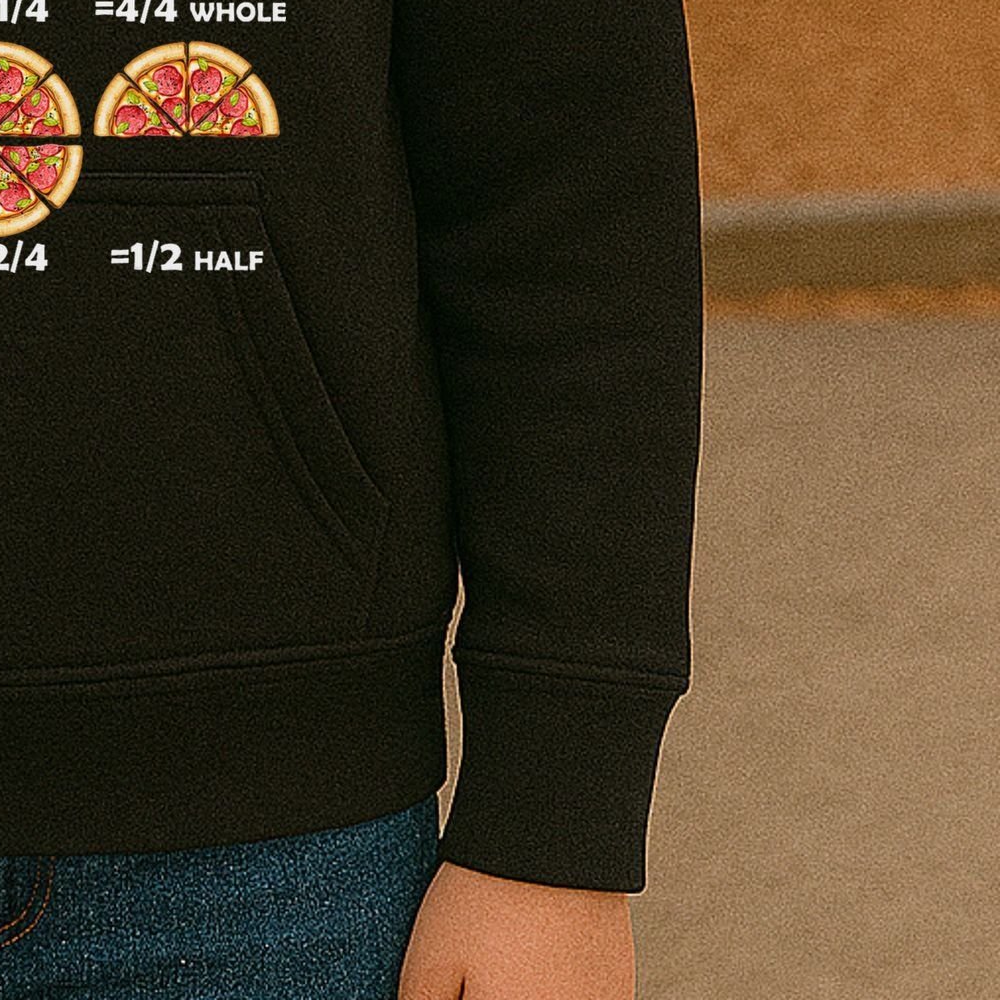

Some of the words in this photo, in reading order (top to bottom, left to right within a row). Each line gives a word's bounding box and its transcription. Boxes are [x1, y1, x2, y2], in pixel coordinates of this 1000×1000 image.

[189, 1, 287, 23] WHOLE
[110, 240, 183, 273] =1/2
[194, 250, 264, 271] HALF
